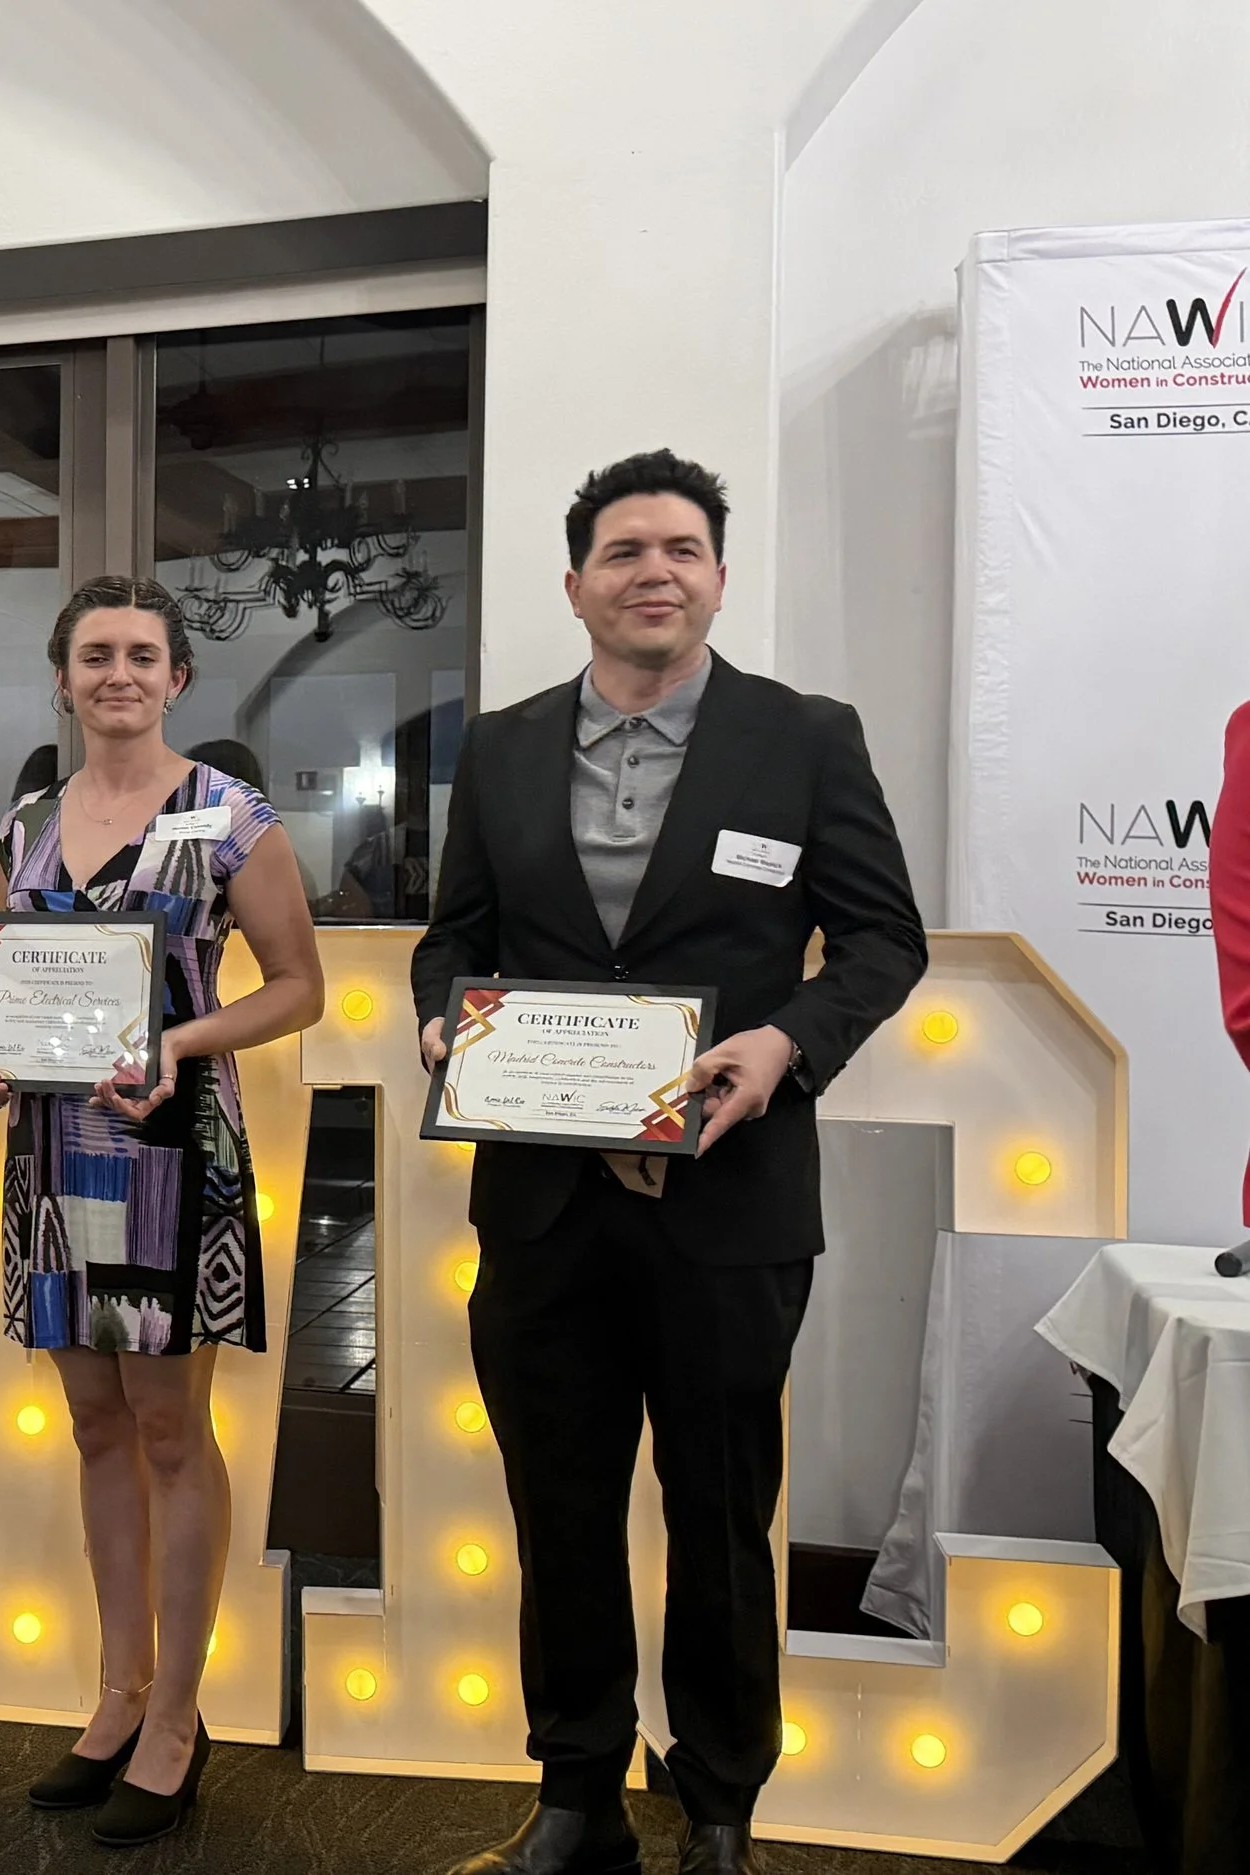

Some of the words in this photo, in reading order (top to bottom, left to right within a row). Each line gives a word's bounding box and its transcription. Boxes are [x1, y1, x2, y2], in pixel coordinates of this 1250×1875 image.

[1079, 360, 1103, 372] The
[1106, 356, 1176, 372] National
[1079, 375, 1151, 389] Women
[1156, 377, 1169, 388] in
[1109, 413, 1149, 429] San
[1157, 411, 1226, 431] Diego,
[1233, 410, 1250, 426] C
[1076, 856, 1100, 869] The
[1104, 855, 1174, 871] National
[1076, 871, 1147, 888] Women
[1152, 876, 1165, 888] in
[1105, 911, 1145, 928] San
[1151, 912, 1214, 934] Diego
[12, 950, 107, 965] CERTIFICATE
[29, 990, 76, 1006] Electrical
[78, 990, 121, 1008] Services
[517, 1012, 640, 1030] CERTIFICATE
[487, 1050, 537, 1065] Madrid
[540, 1052, 586, 1068] Concrete
[589, 1055, 658, 1072] Constructors
[541, 1090, 586, 1104] NAWIC
